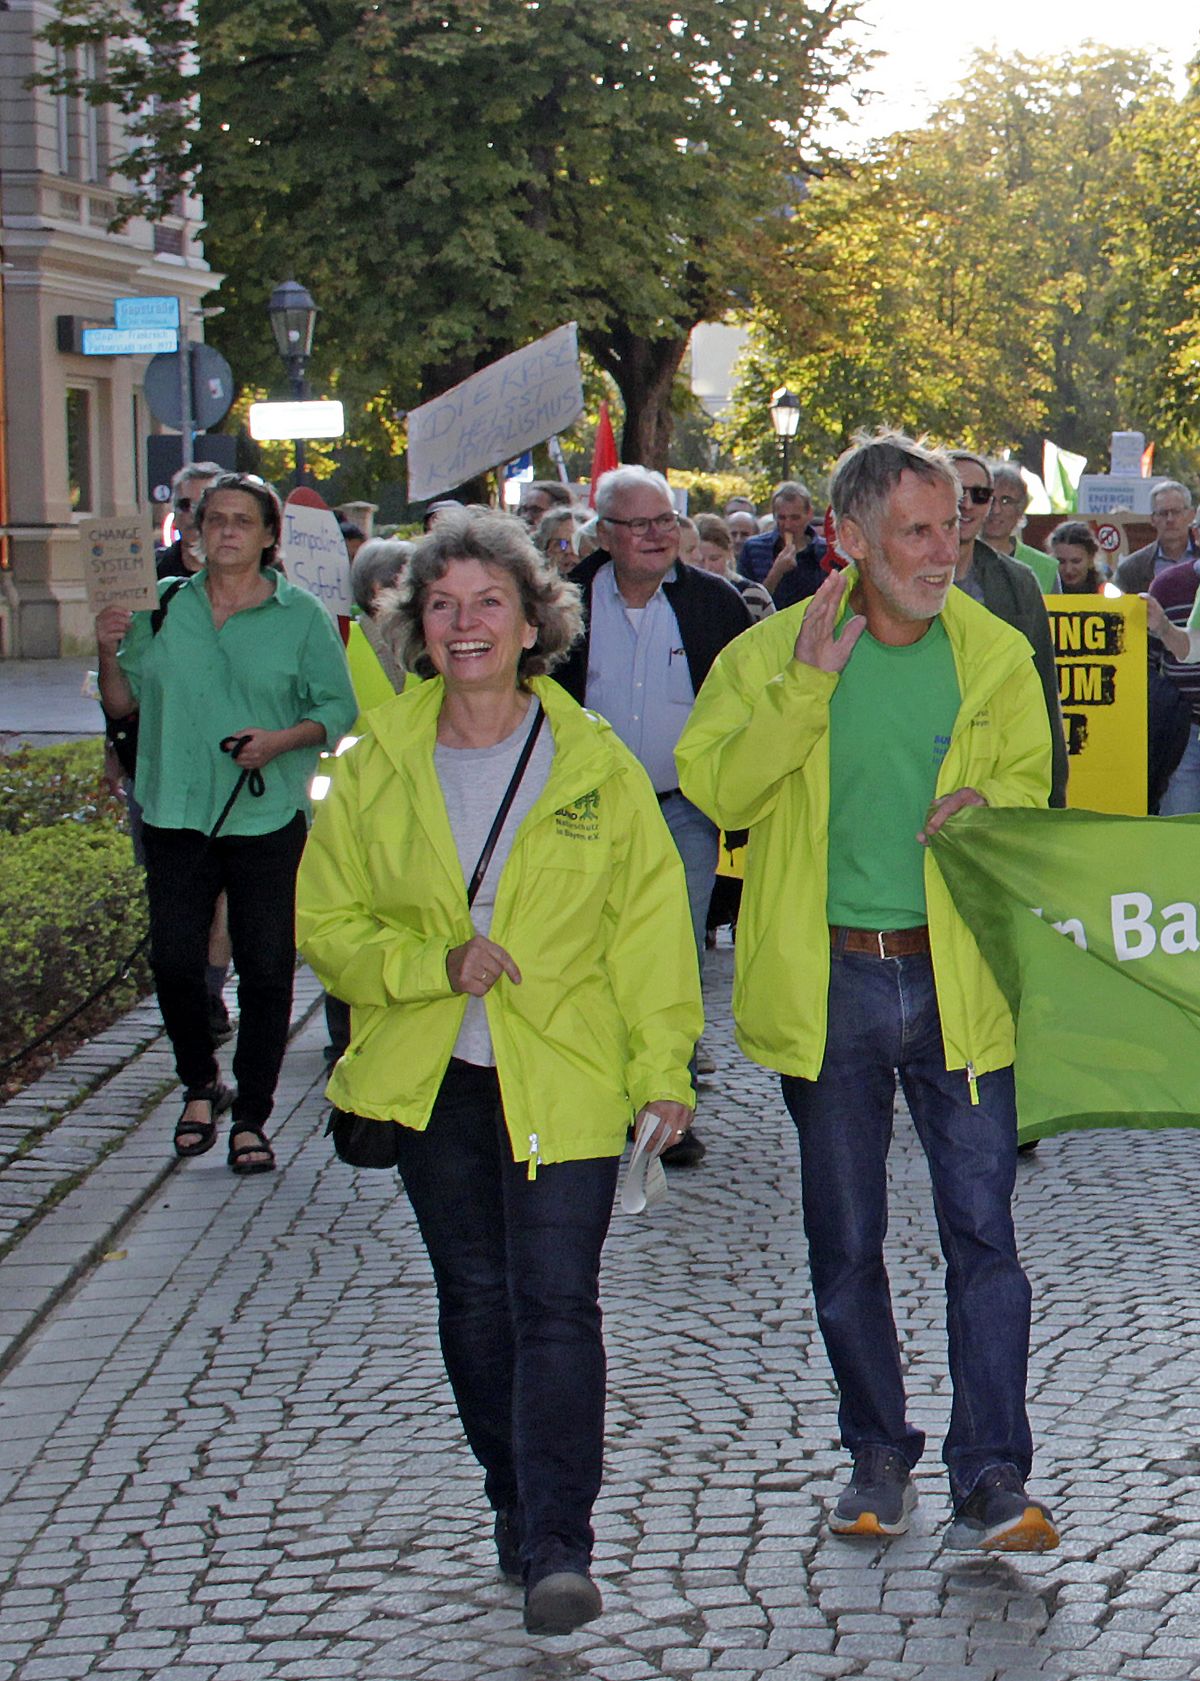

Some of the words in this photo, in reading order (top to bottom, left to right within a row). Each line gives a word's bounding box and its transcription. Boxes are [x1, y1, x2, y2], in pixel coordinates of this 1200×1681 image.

[421, 375, 495, 441] DIE
[89, 528, 142, 541] CHANGE
[91, 558, 145, 573] SYSTEM
